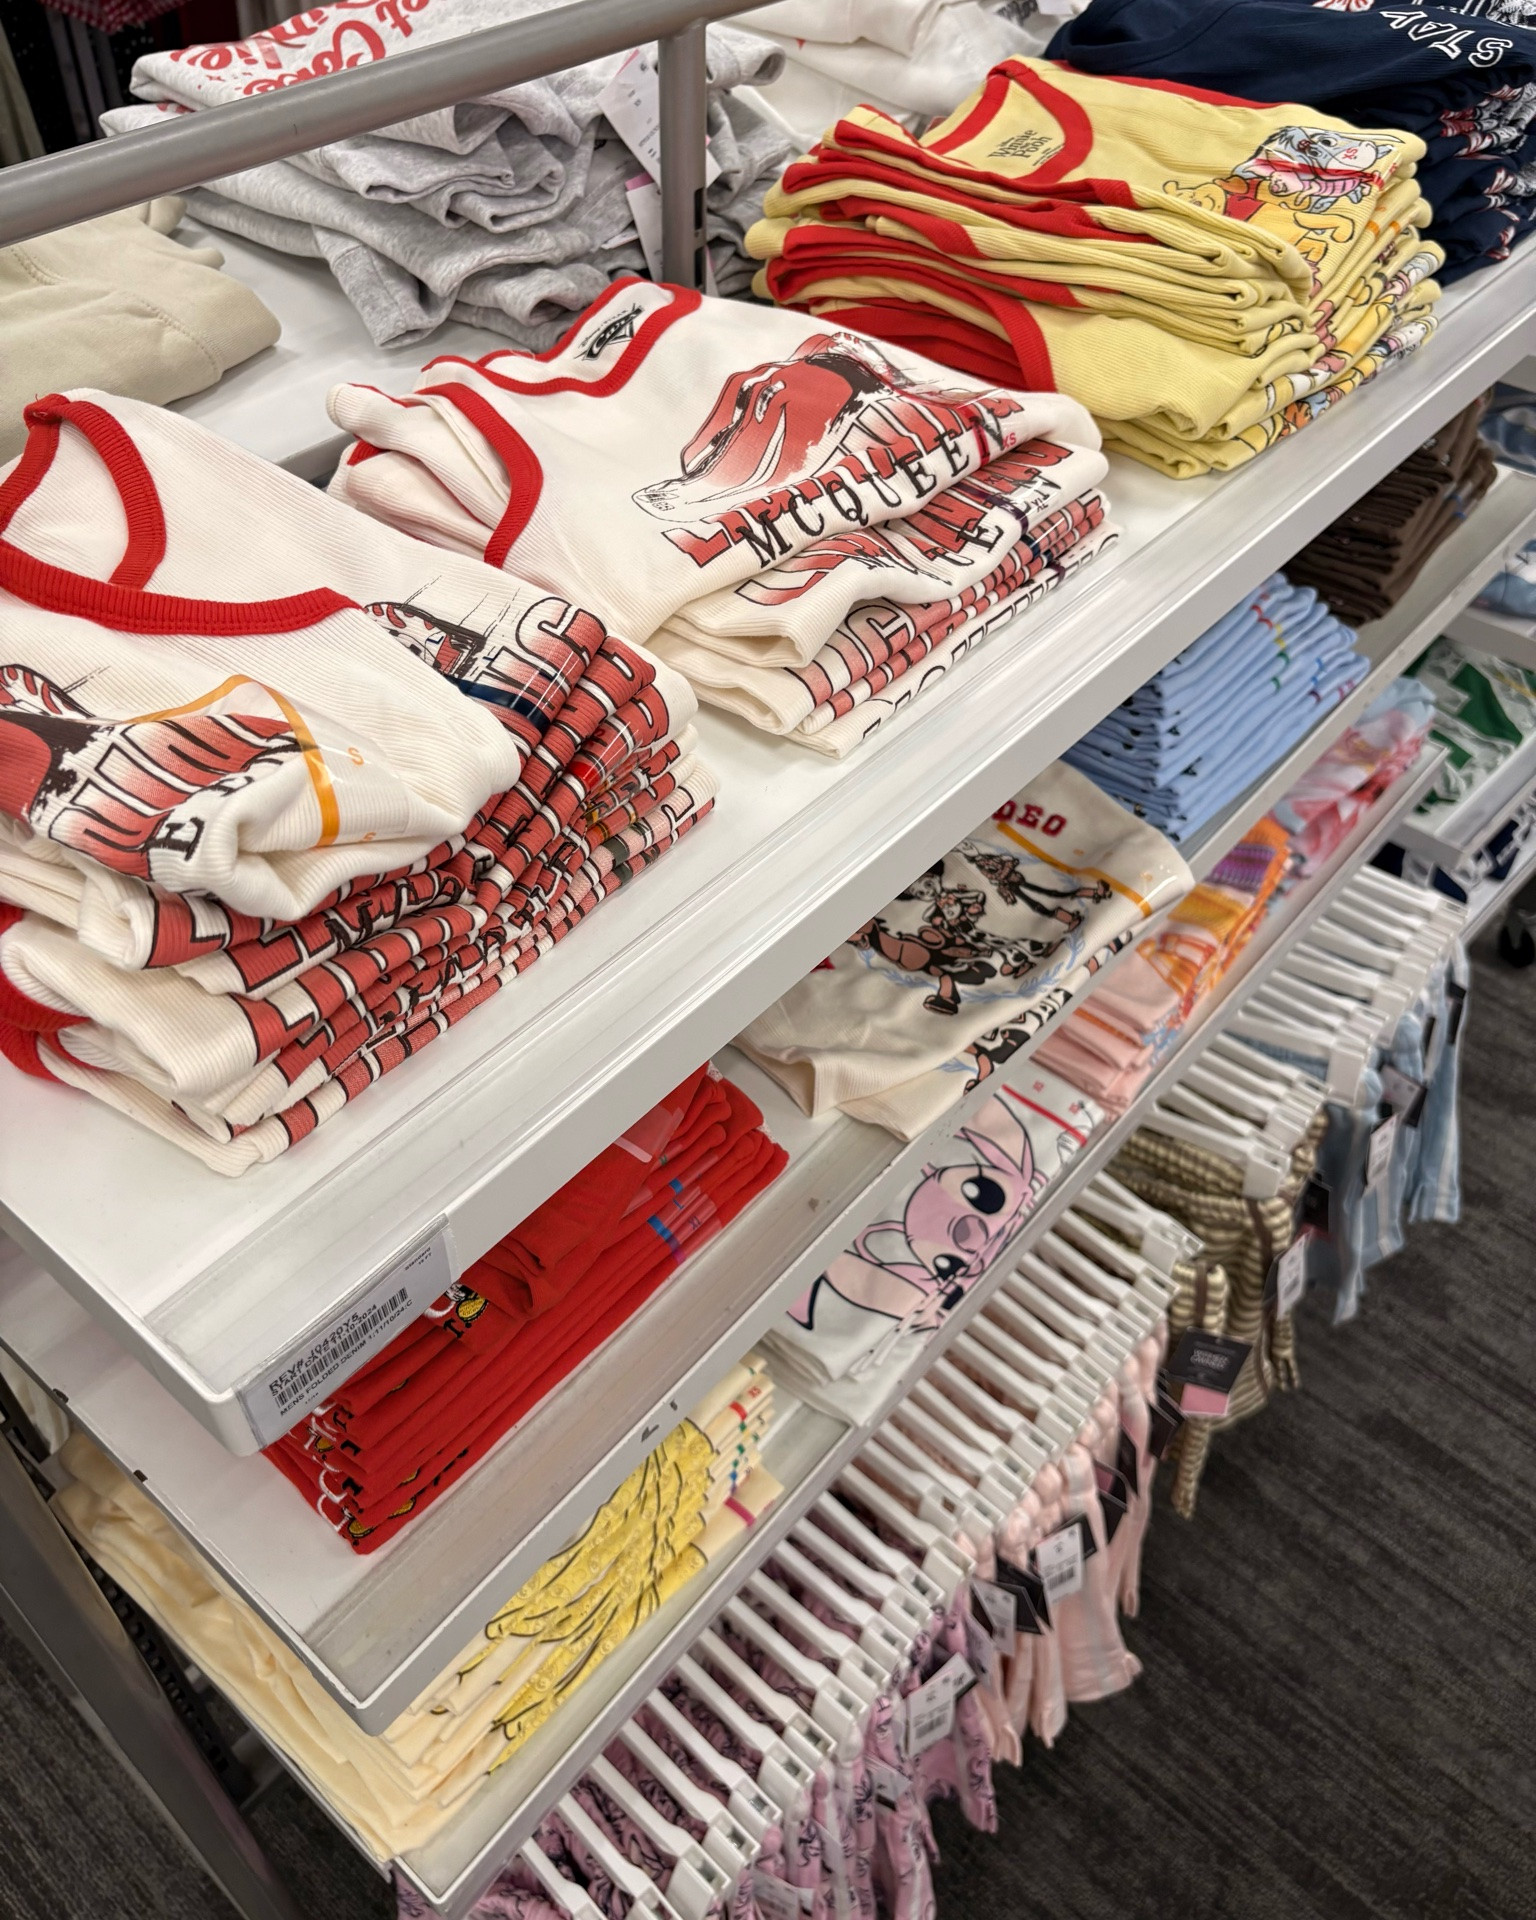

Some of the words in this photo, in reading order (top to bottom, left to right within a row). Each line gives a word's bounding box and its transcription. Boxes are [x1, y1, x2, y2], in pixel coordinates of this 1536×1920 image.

[1379, 10, 1514, 68] STAY
[305, 1362, 340, 1395] FOLDED
[340, 1339, 368, 1365] DENIM
